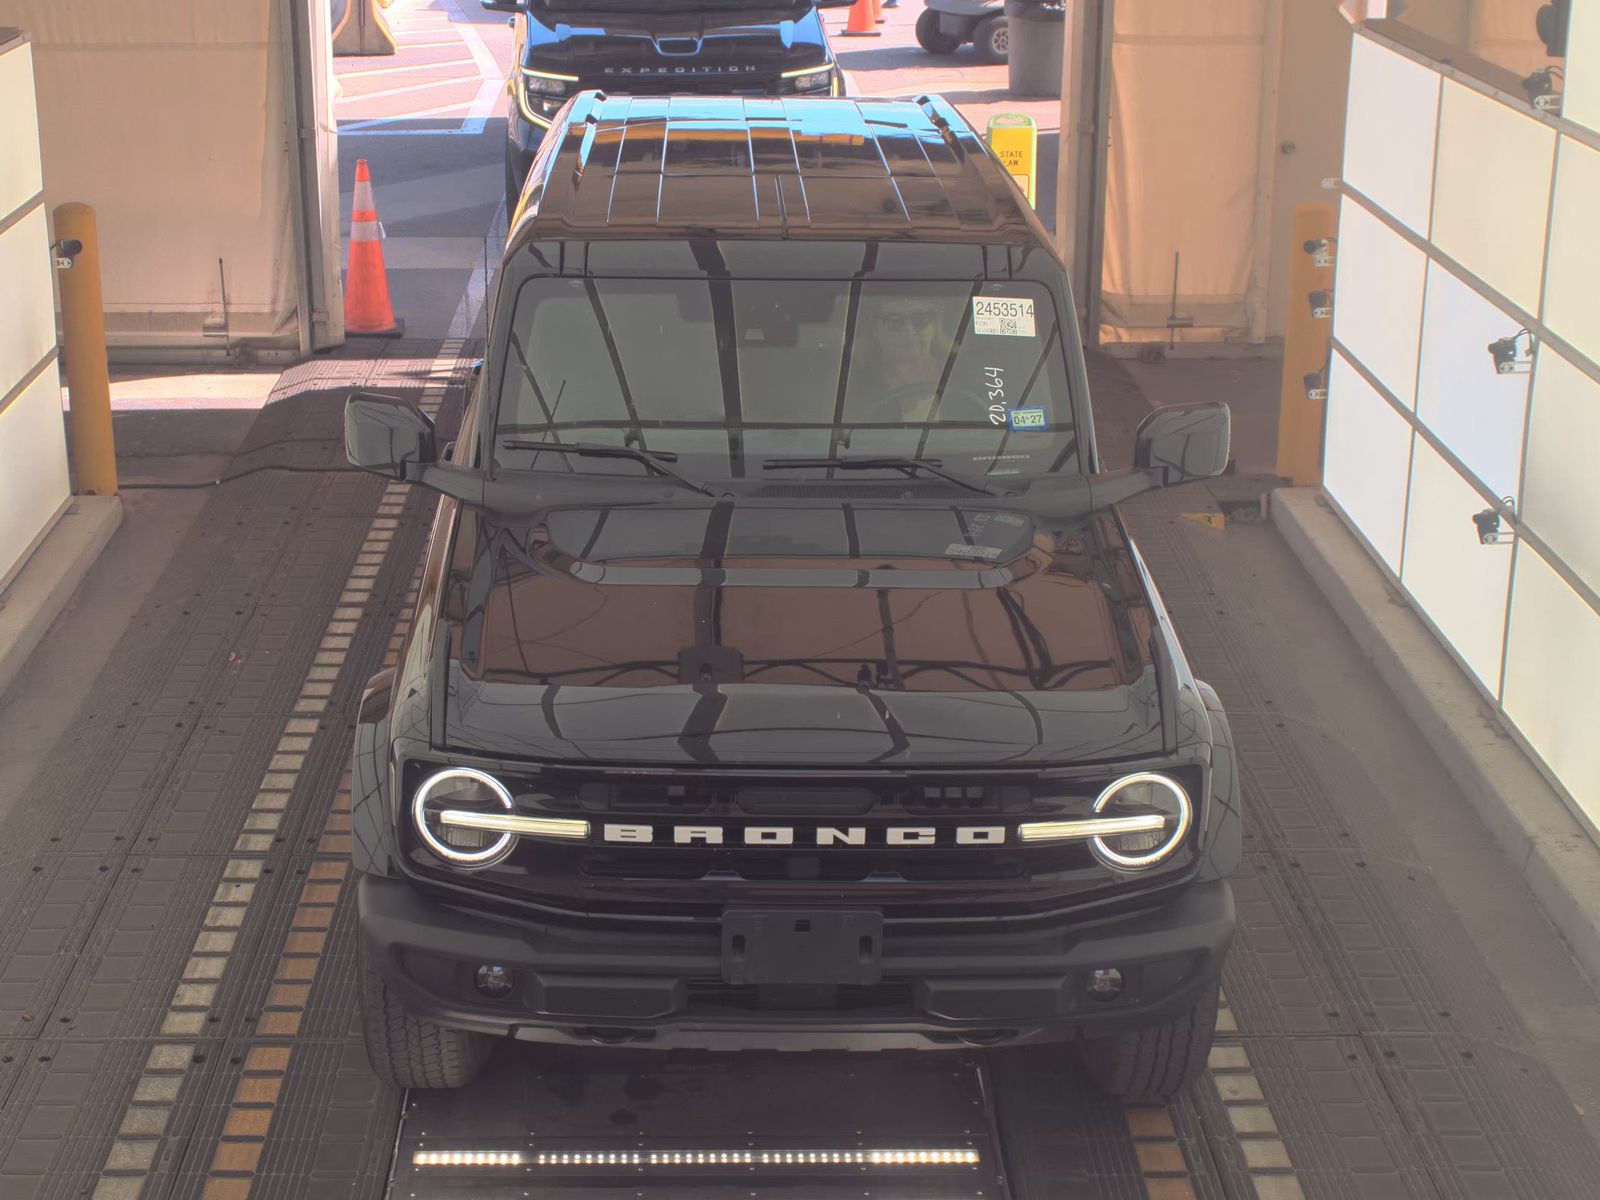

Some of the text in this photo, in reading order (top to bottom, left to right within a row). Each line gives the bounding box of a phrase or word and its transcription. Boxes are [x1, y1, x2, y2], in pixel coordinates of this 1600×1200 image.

[604, 65, 756, 74] EXPEDITION
[1000, 150, 1024, 158] STATE
[976, 301, 1035, 318] 2453514
[984, 366, 1008, 425] 20,364
[1013, 414, 1042, 425] 04 27
[603, 823, 1006, 845] BRONCO
